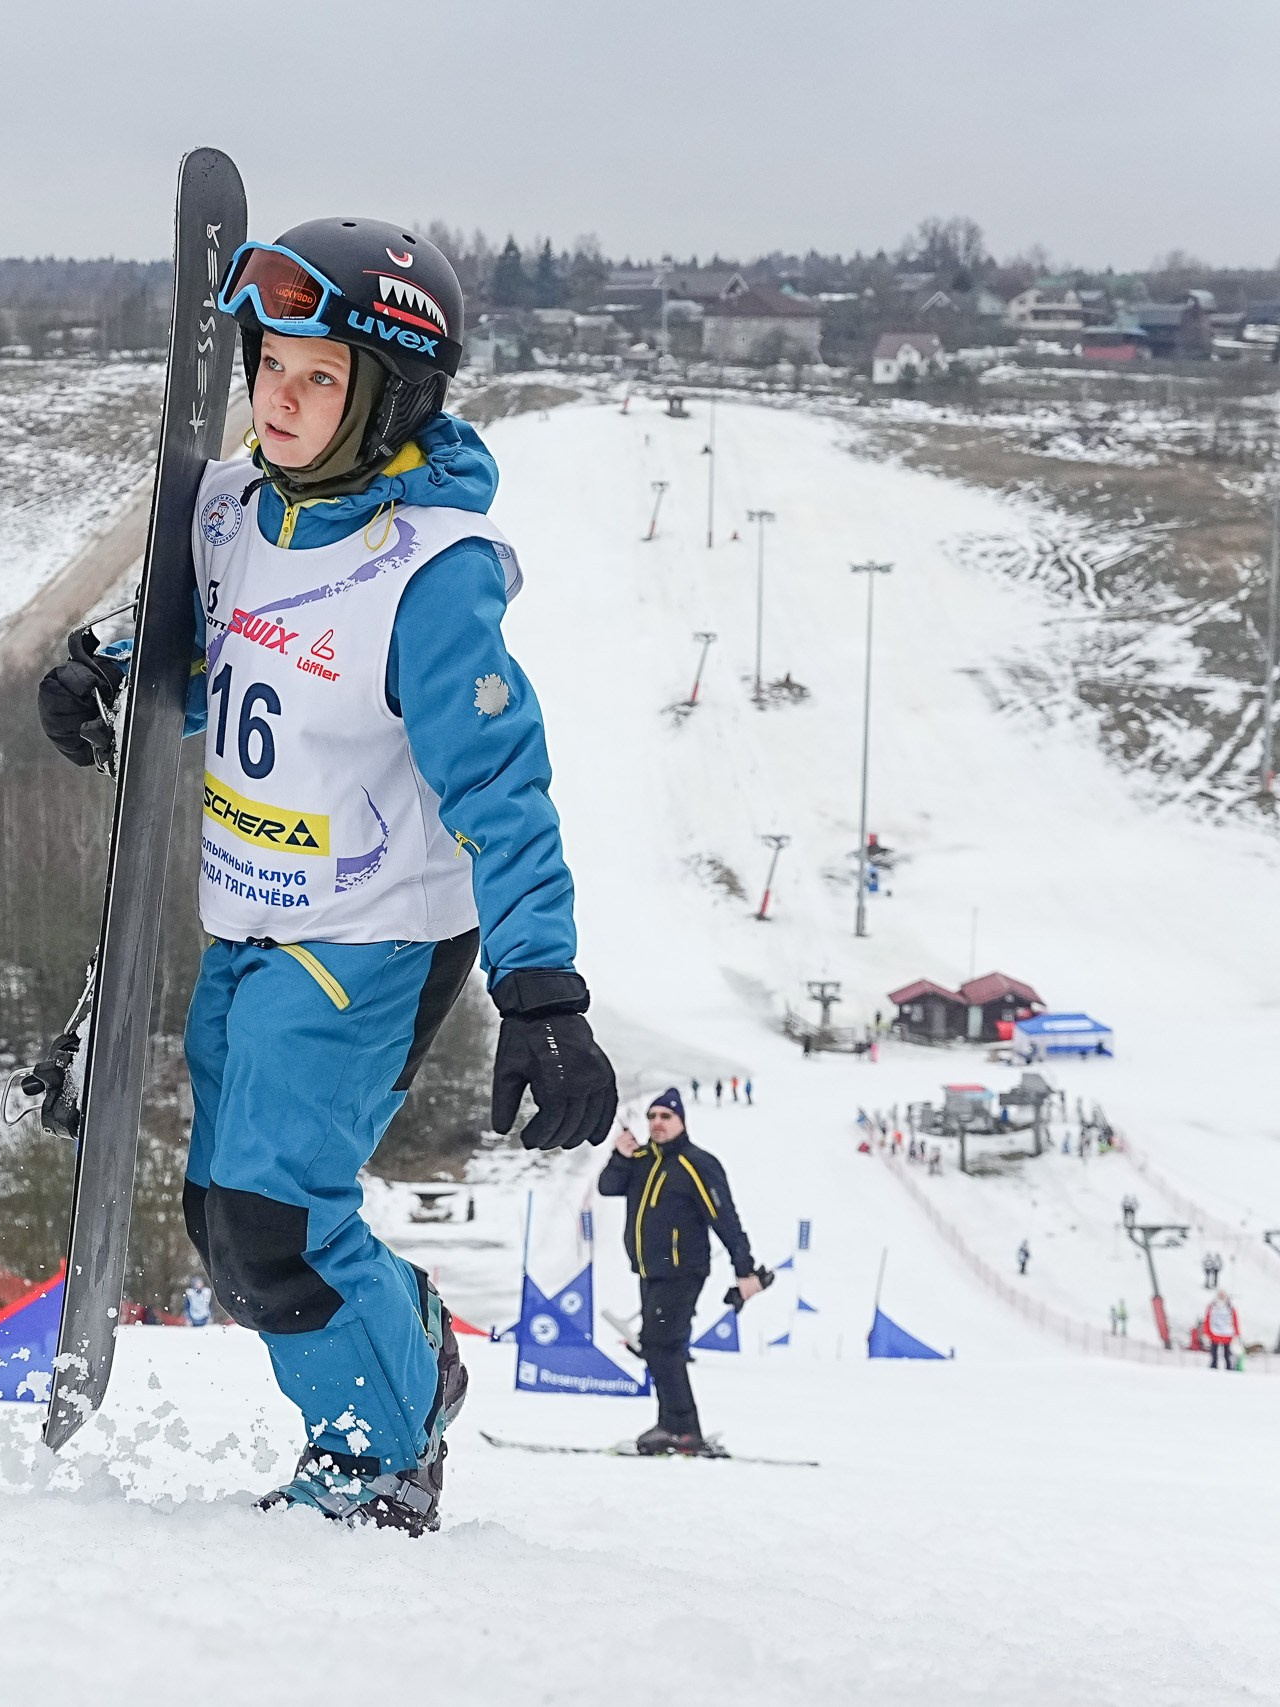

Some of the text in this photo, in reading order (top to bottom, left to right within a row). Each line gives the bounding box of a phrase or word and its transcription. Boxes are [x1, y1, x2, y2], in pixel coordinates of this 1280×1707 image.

[347, 309, 439, 358] uvex
[207, 615, 227, 631] OTT
[228, 607, 299, 655] SWIX
[296, 656, 340, 682] Löffler
[211, 662, 282, 780] 16
[204, 788, 286, 844] SCHER
[201, 836, 307, 888] олыжный клуб
[224, 873, 310, 908] ТЯГАЧЁВА
